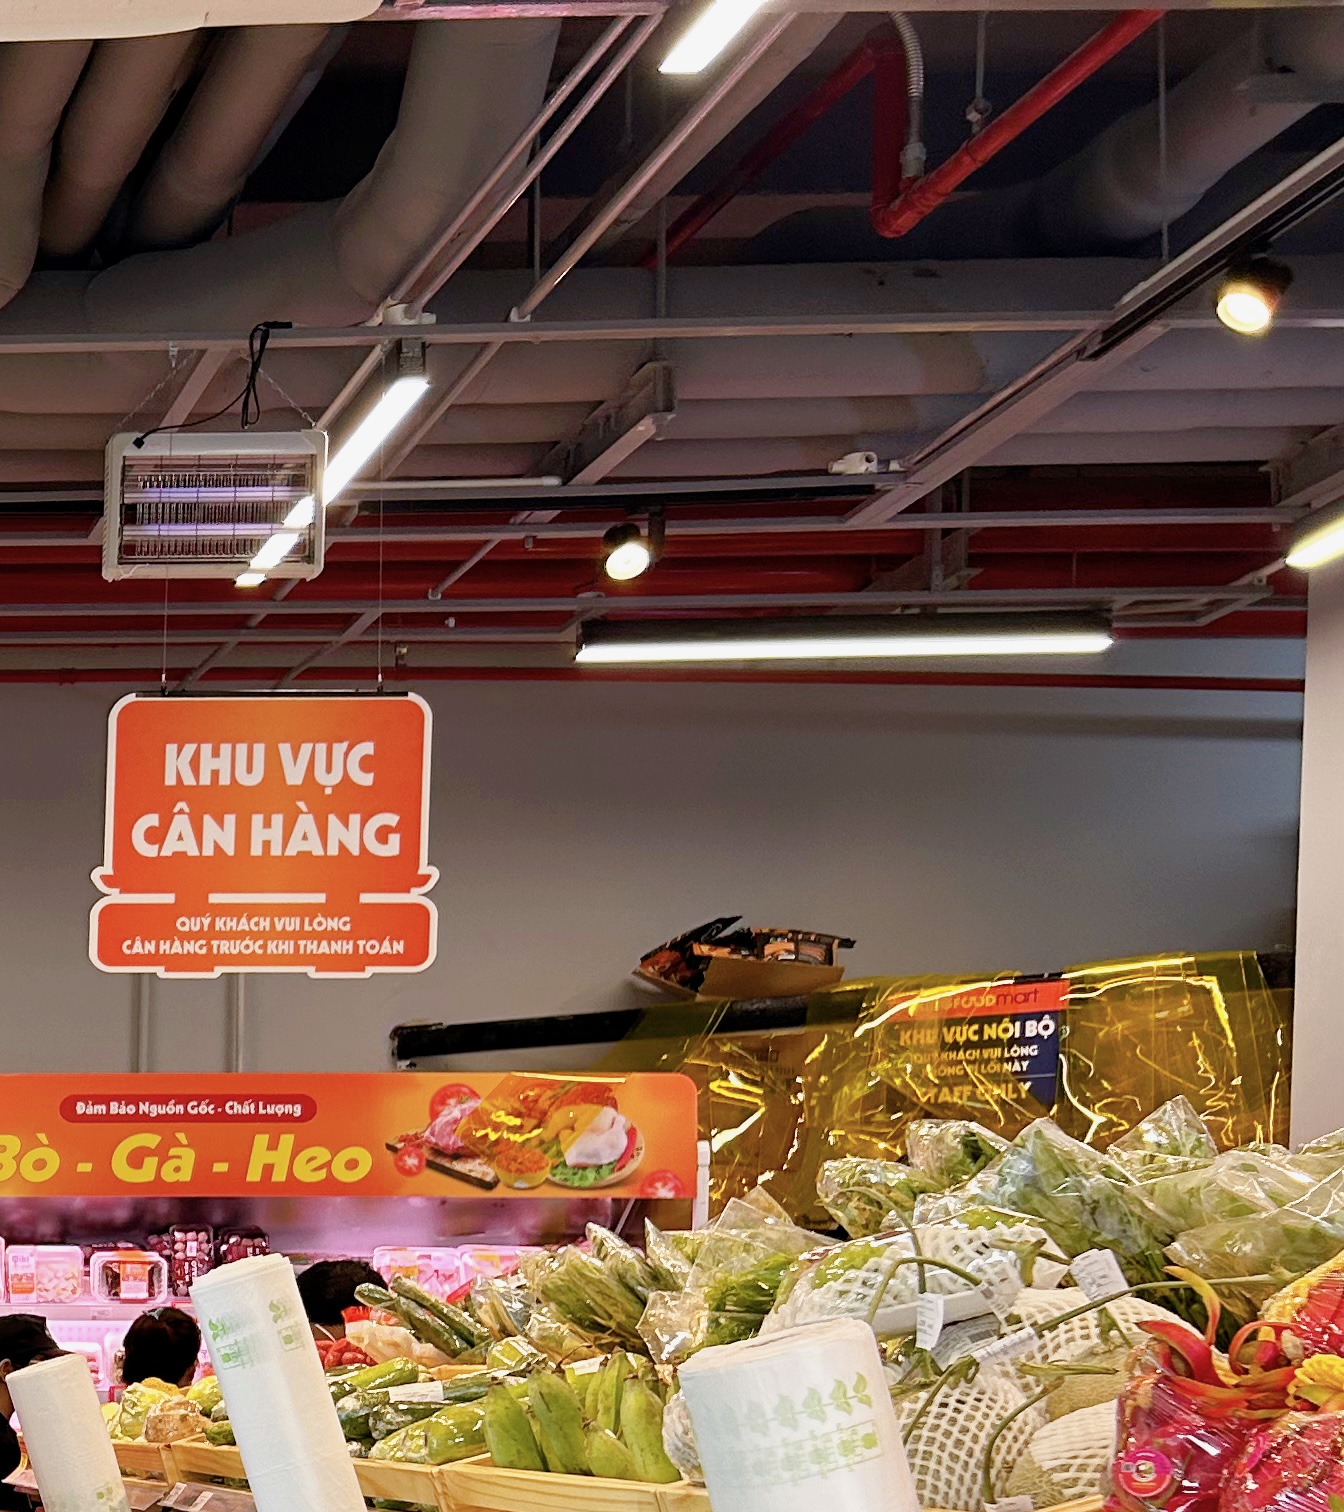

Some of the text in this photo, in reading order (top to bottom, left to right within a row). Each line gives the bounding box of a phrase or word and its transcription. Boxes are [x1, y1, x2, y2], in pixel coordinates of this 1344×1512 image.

[165, 741, 375, 795] KHU VỰC
[131, 801, 400, 857] CÂN HÀNG
[176, 913, 350, 932] QUÝ KHÁCH VUI LÒNG
[122, 937, 405, 955] CÂN HÀNG TRƯỚC KHI THANH TOÁN
[942, 1023, 978, 1045] VỰC
[983, 1017, 1020, 1043] NỘI
[1024, 1013, 1055, 1040] BỘ
[75, 1100, 107, 1115] Đảm
[109, 1100, 136, 1114] Bảo
[139, 1100, 184, 1117] Nguồn
[187, 1099, 215, 1114] Gốc
[224, 1099, 255, 1114] Chất
[258, 1101, 302, 1117] Lượng
[76, 1161, 93, 1172] -
[112, 1131, 193, 1183] Gà
[213, 1161, 229, 1172] -
[245, 1132, 373, 1183] Heo
